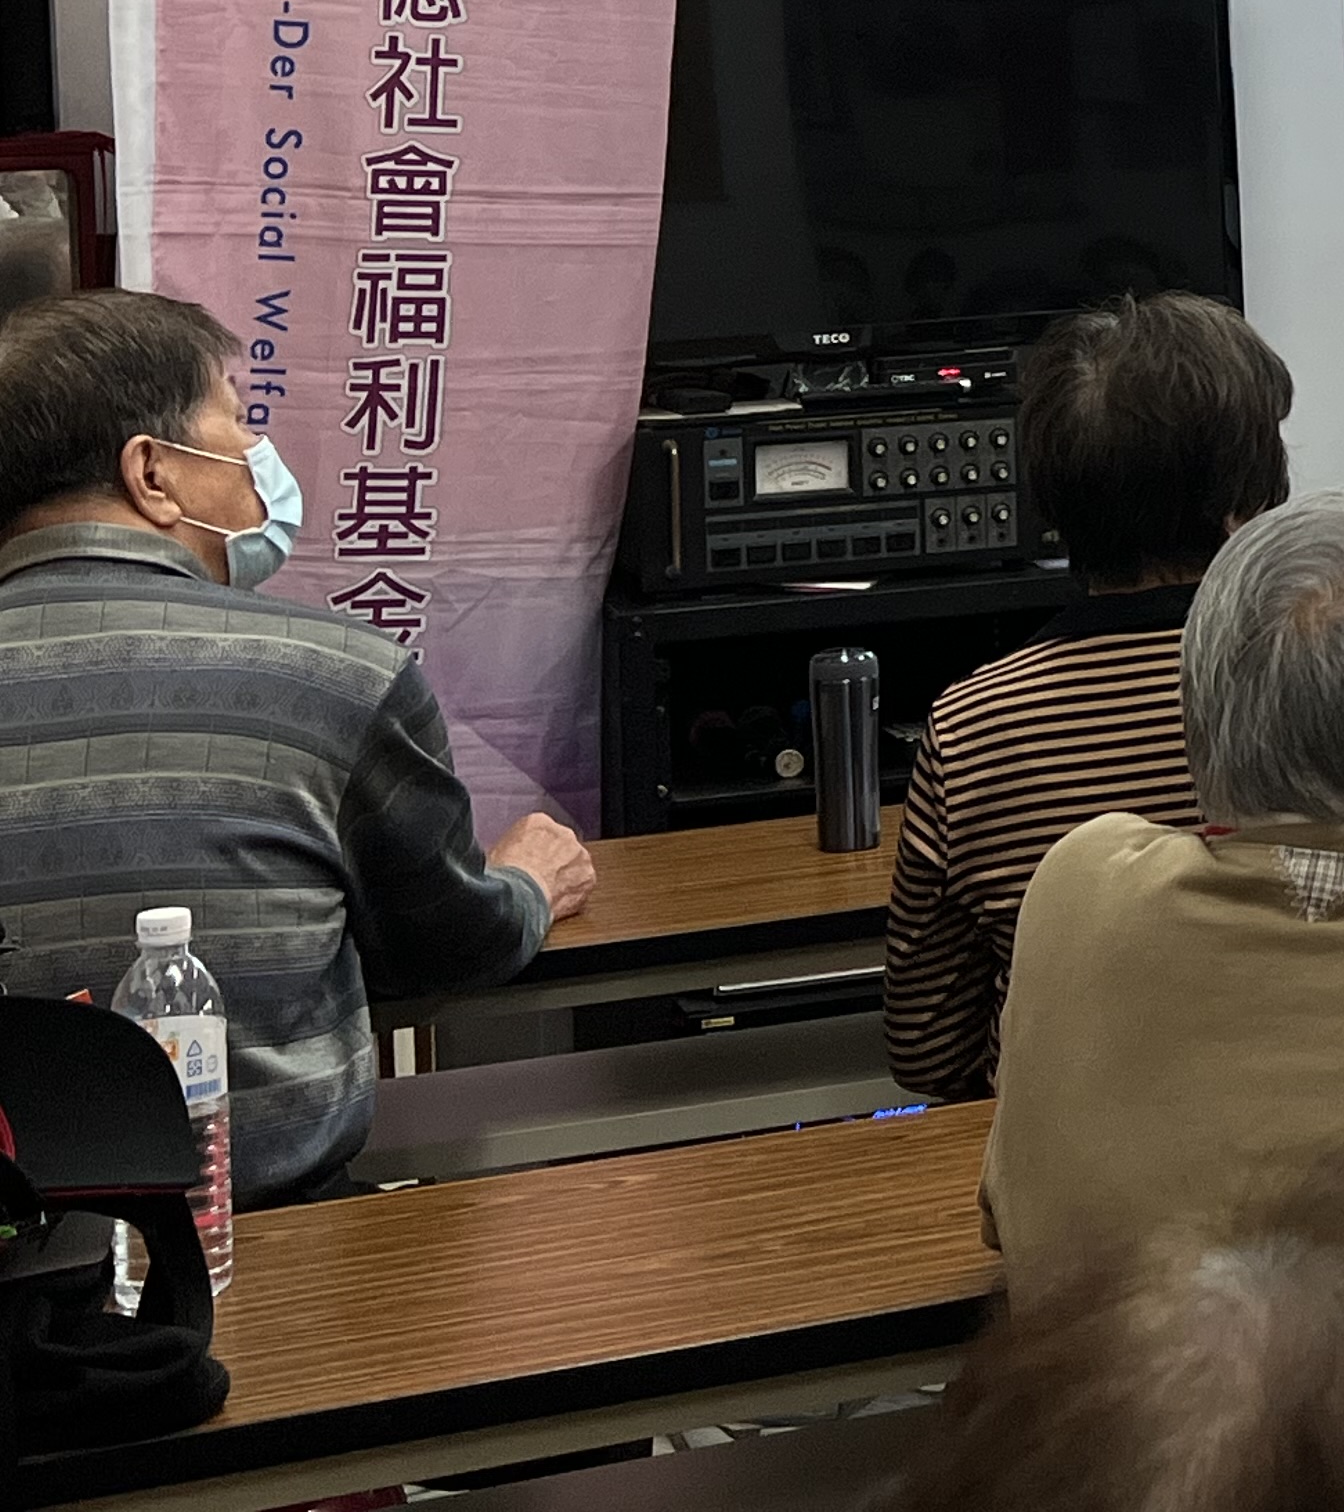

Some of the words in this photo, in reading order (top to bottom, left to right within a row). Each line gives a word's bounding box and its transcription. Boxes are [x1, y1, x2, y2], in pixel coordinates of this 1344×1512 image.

[257, 128, 303, 261] Social
[247, 291, 290, 430] Welfa
[813, 333, 850, 345] TECO
